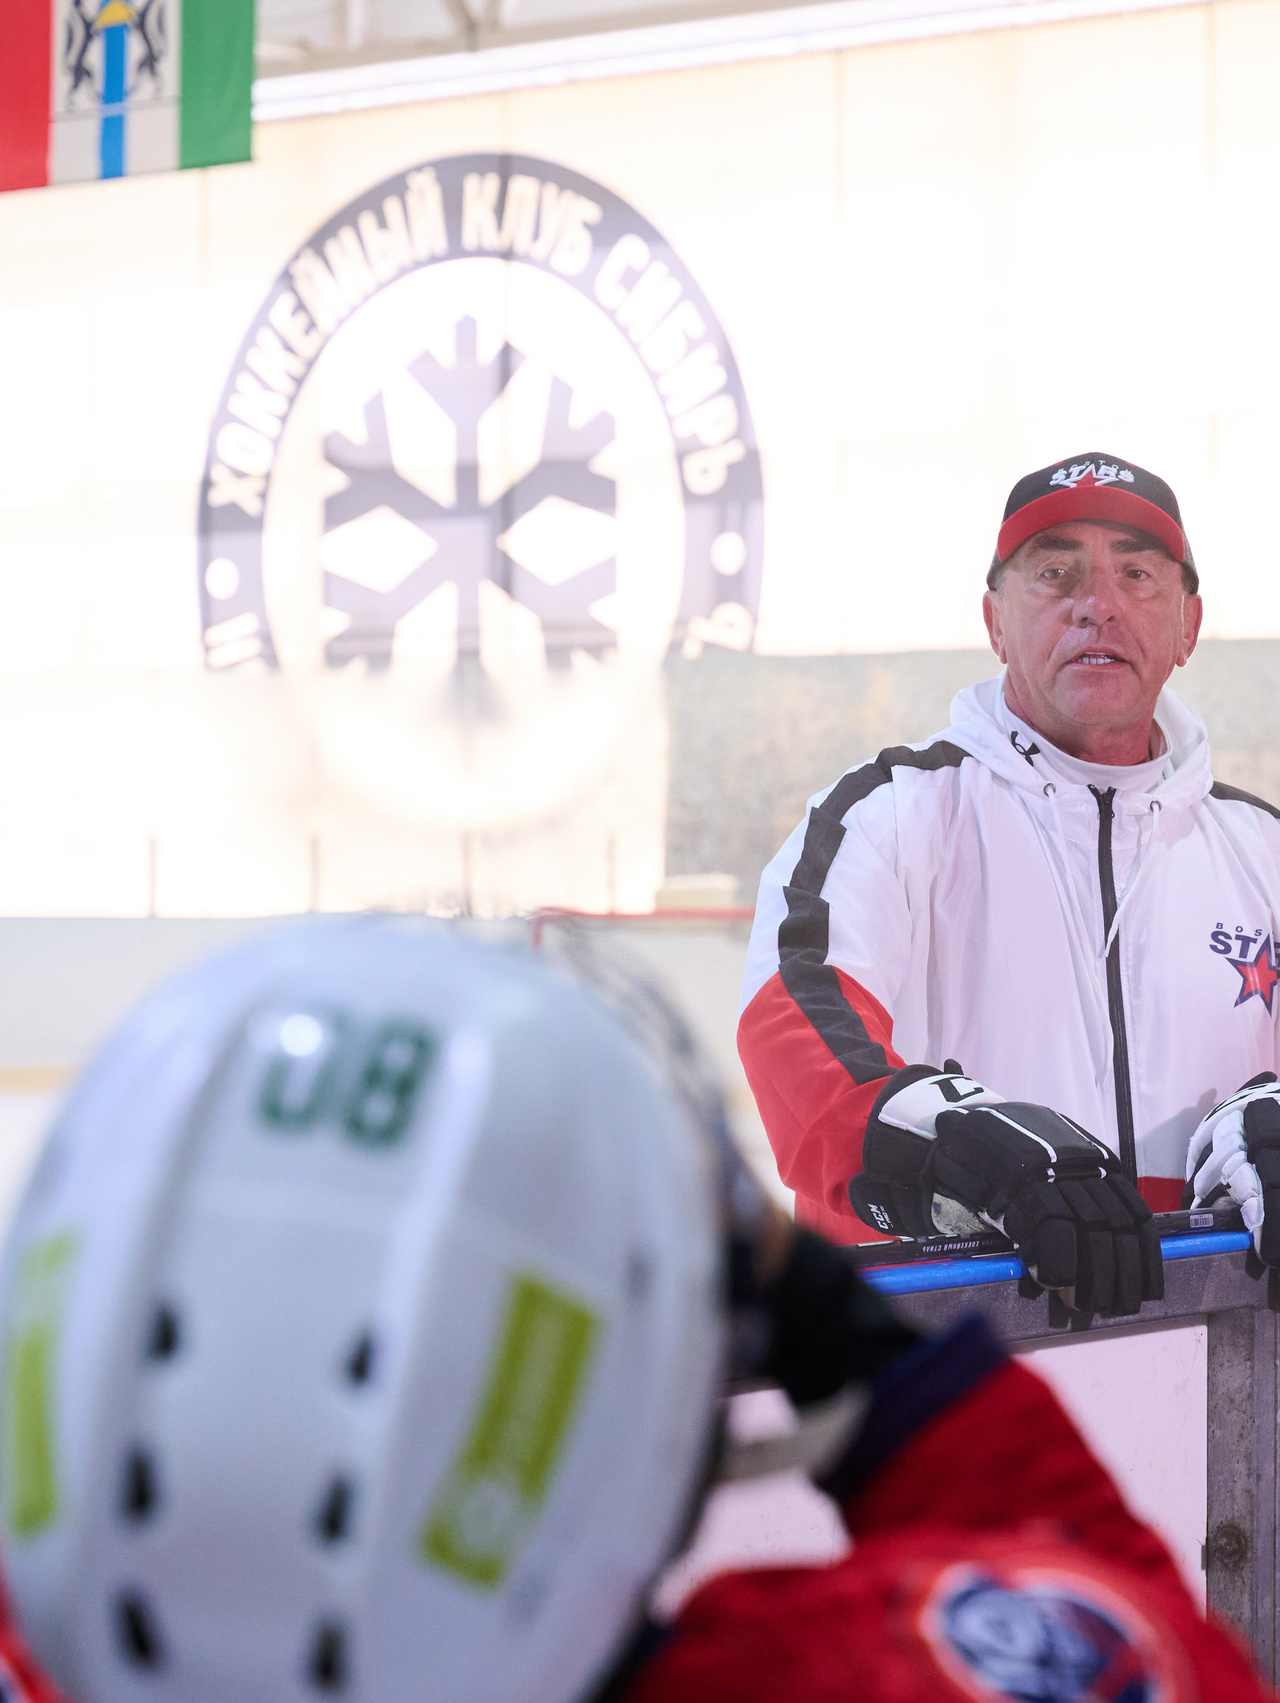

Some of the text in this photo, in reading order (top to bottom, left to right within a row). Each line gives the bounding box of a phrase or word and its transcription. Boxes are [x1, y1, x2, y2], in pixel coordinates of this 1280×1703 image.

[206, 165, 747, 518] ХОККЕЙНЫЙ КЛУБ СИБИРЬ
[867, 1203, 889, 1230] CCM
